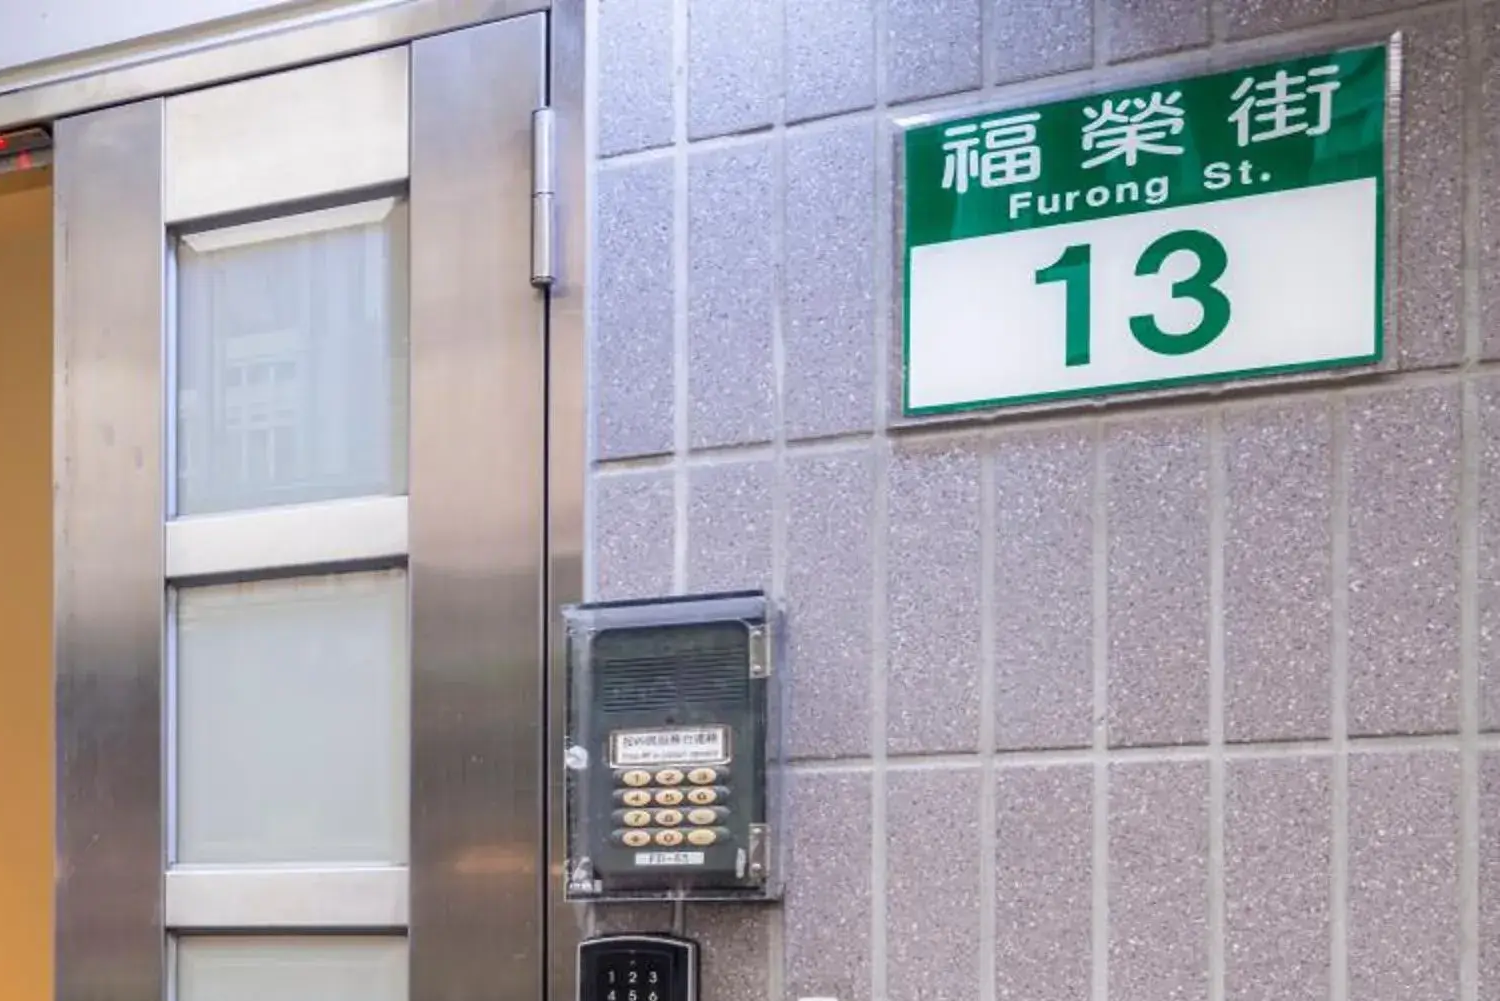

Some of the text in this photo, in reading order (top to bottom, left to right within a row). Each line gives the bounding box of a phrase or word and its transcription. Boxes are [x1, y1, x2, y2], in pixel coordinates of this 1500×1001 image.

[941, 64, 1342, 194] 福榮街
[1009, 161, 1272, 219] Furong St.
[1034, 229, 1232, 367] 13
[606, 989, 617, 1001] 4
[607, 969, 659, 984] 1 2 3
